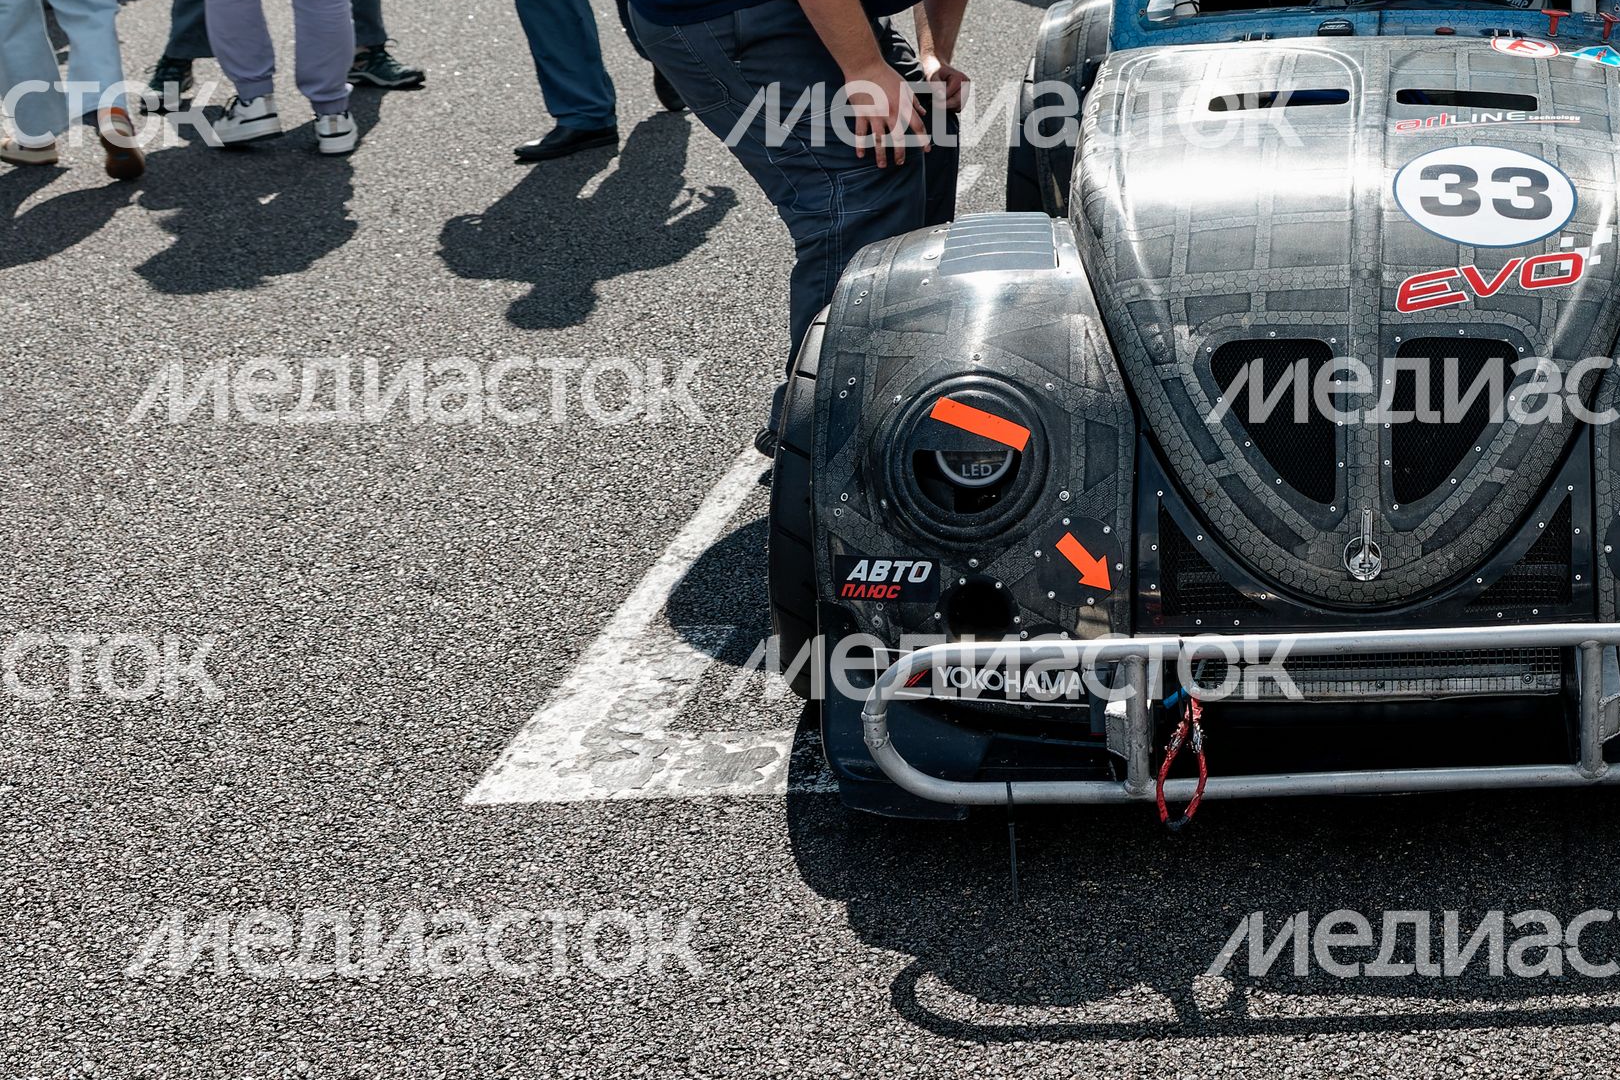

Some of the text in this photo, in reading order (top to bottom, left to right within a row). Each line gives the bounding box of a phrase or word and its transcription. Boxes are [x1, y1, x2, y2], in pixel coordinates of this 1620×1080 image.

[1419, 163, 1554, 221] 33
[1395, 252, 1583, 313] EVO
[961, 462, 993, 479] LED
[846, 559, 933, 584] АВТО
[840, 584, 902, 600] ПЛЮС
[937, 665, 1088, 696] YOKOHAMA
